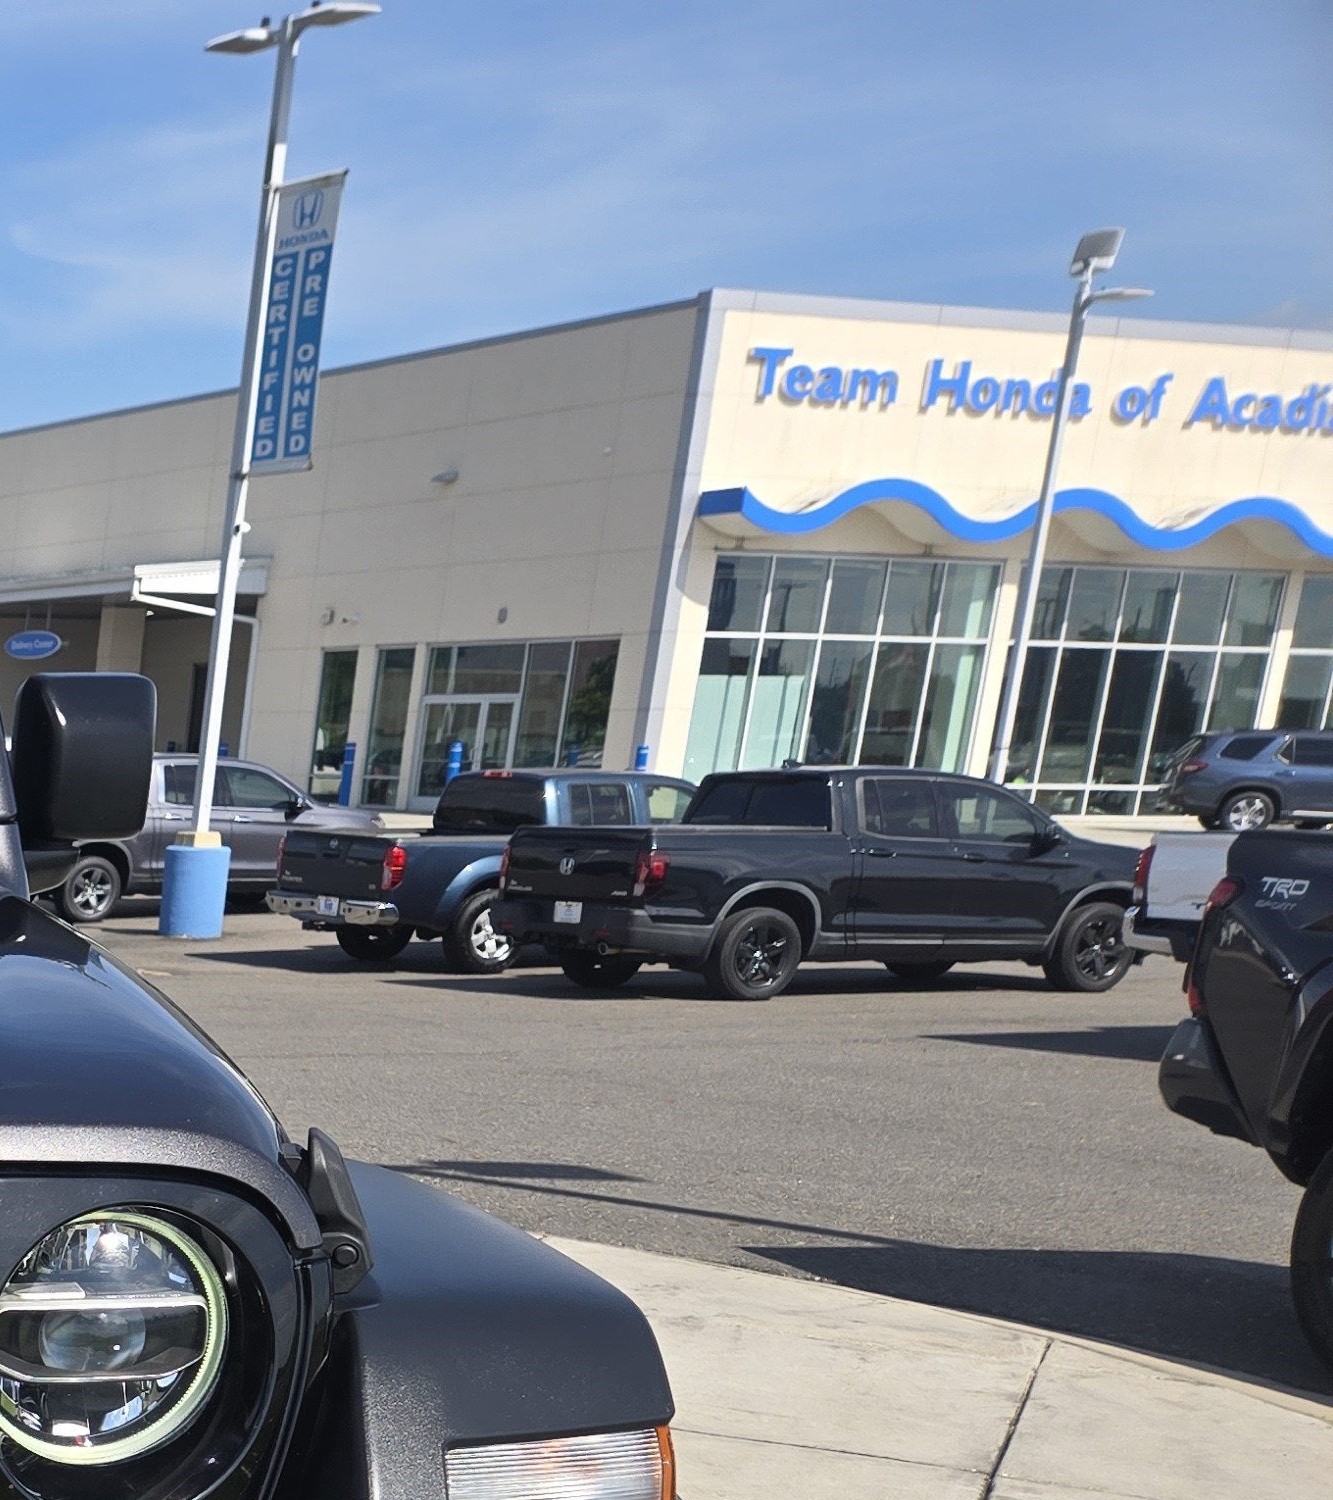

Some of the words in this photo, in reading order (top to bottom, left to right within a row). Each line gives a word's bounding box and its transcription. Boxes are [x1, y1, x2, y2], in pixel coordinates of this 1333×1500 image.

[278, 228, 329, 249] HONDA
[302, 250, 326, 317] PRE
[254, 258, 294, 456] CERTIFIED
[748, 346, 899, 407] Team
[920, 357, 1093, 416] Honda
[1114, 372, 1174, 425] of
[289, 343, 315, 454] OWNED
[1261, 876, 1310, 899] TRD
